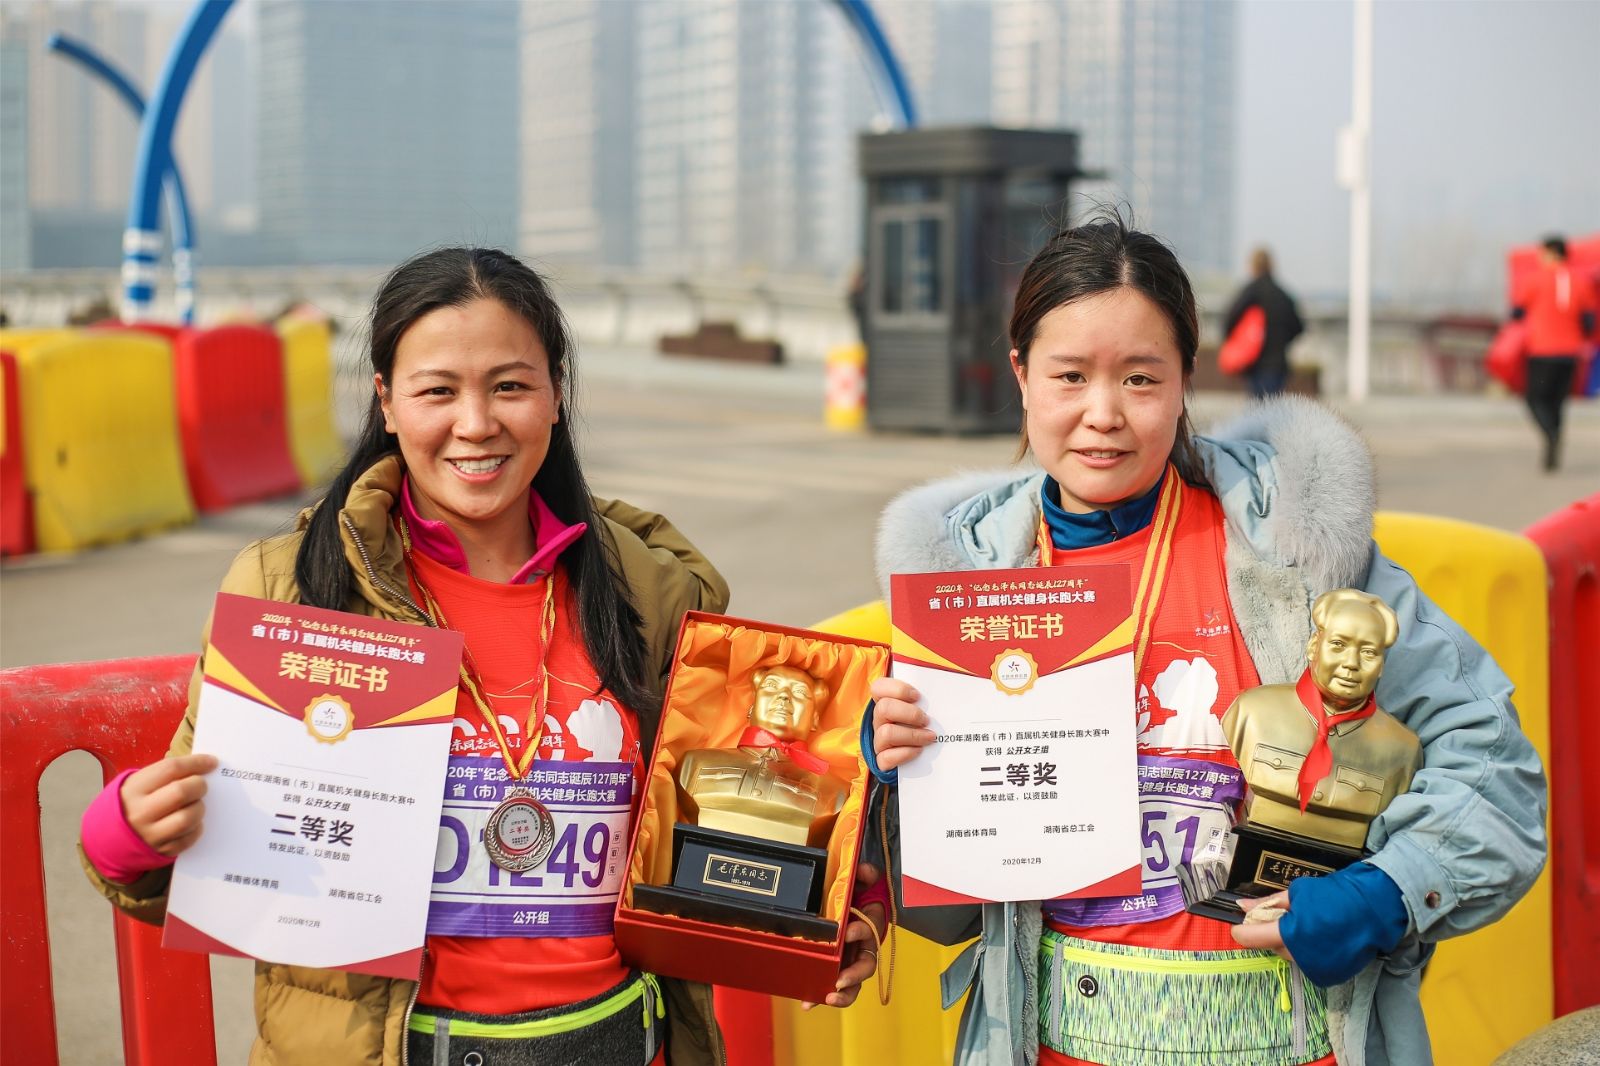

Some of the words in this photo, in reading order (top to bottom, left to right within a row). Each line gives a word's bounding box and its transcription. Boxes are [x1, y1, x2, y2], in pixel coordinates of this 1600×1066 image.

[929, 591, 1096, 610] 省（市）直属机关健身长跑大赛
[960, 612, 1064, 643] 荣誉证书
[251, 624, 426, 665] 省（市）直属机关健身长跑大赛
[279, 651, 390, 693] 荣誉证书
[934, 729, 1110, 744] 020年湖南省（市）直属机关健身长跑大赛中
[985, 747, 1002, 756] 获得
[1006, 745, 1050, 755] 公开女子组
[979, 762, 1058, 787] 二等奖
[220, 767, 416, 805] 在2020年湖南省（市）直属机关健身长跑大赛中
[282, 793, 301, 804] 获得
[304, 797, 351, 812] 公开女子组
[980, 791, 1058, 802] 特发此证，以资鼓励
[270, 812, 356, 847] 二等奖
[945, 828, 998, 839] 湖南省体育局
[1043, 823, 1096, 834] 湖南省总工会
[268, 841, 351, 862] 特发此证，以资鼓励
[1002, 857, 1042, 866] 2020年12月
[717, 863, 768, 881] 毛泽东同志
[223, 873, 279, 890] 湖南省体育局
[328, 888, 383, 904] 湖南省总工会
[1121, 895, 1159, 912] 公开组
[277, 915, 321, 928] 2020年12月
[512, 911, 550, 925] 公开组
